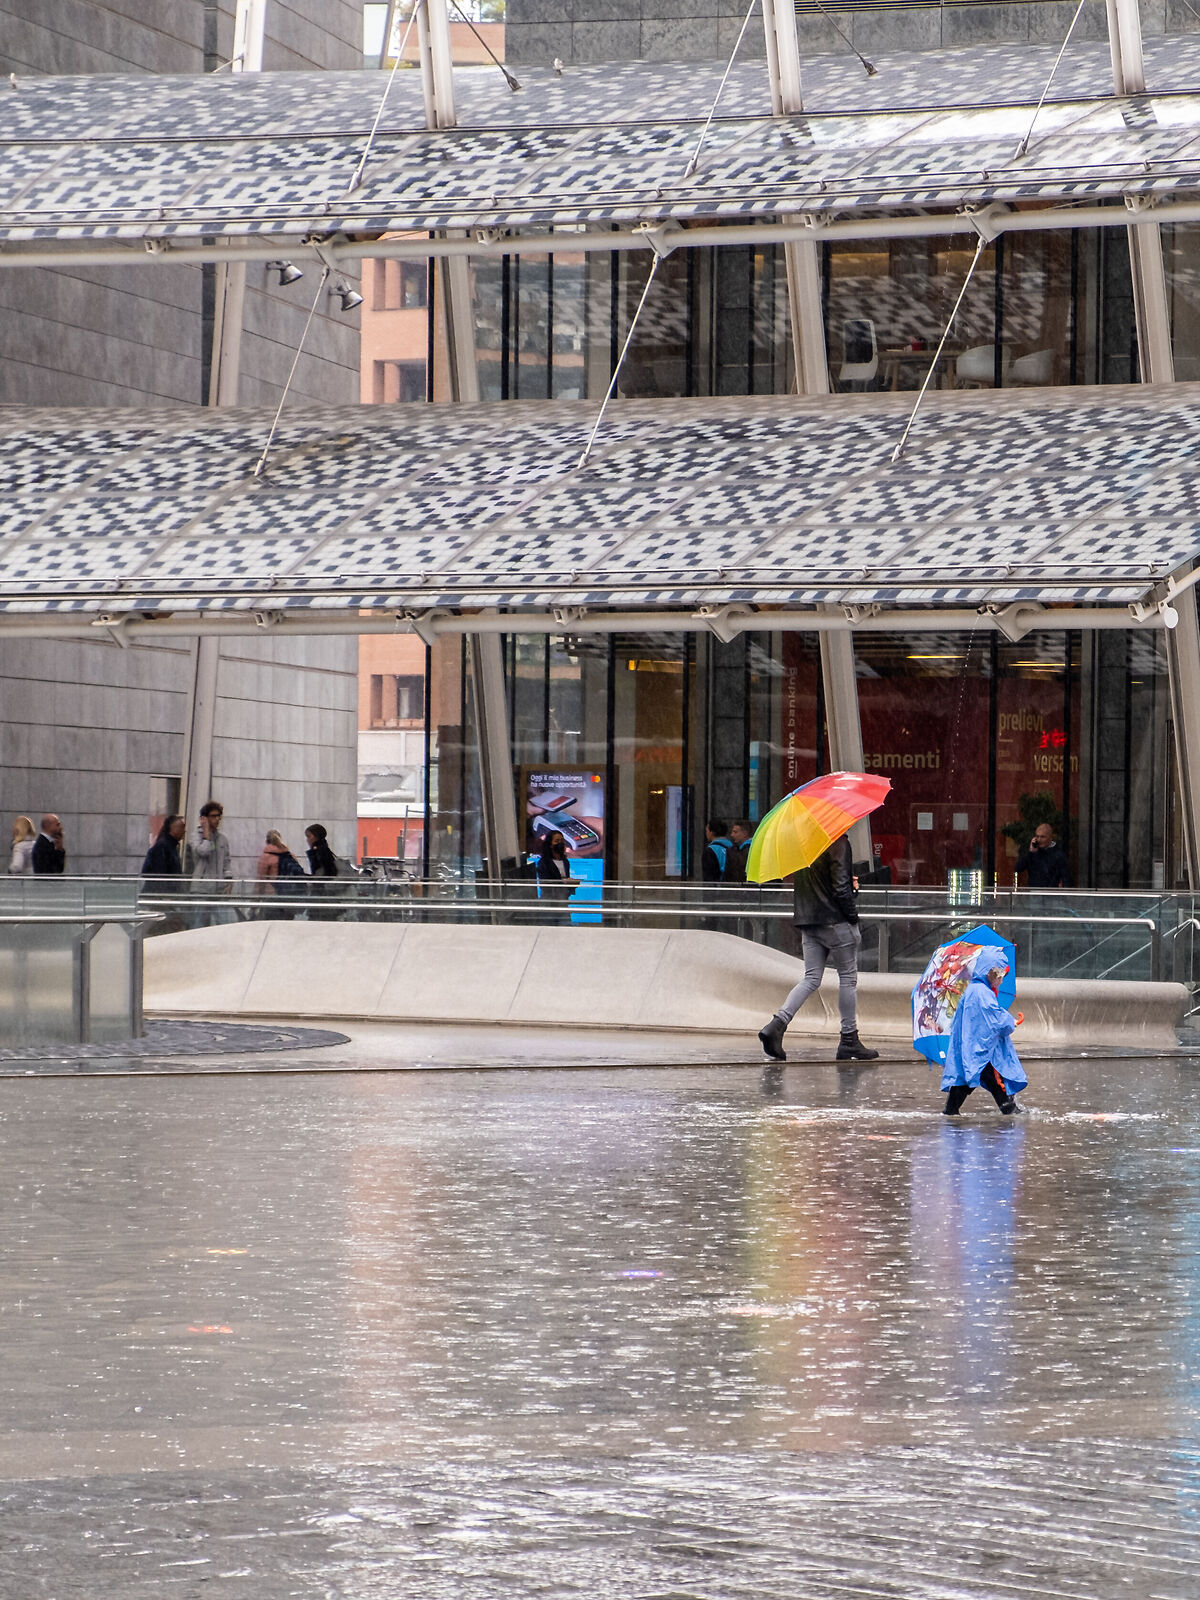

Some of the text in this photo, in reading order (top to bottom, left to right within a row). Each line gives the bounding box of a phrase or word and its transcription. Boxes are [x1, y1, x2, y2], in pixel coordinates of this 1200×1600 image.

[787, 666, 798, 779] online banking
[999, 708, 1043, 737] prelievi
